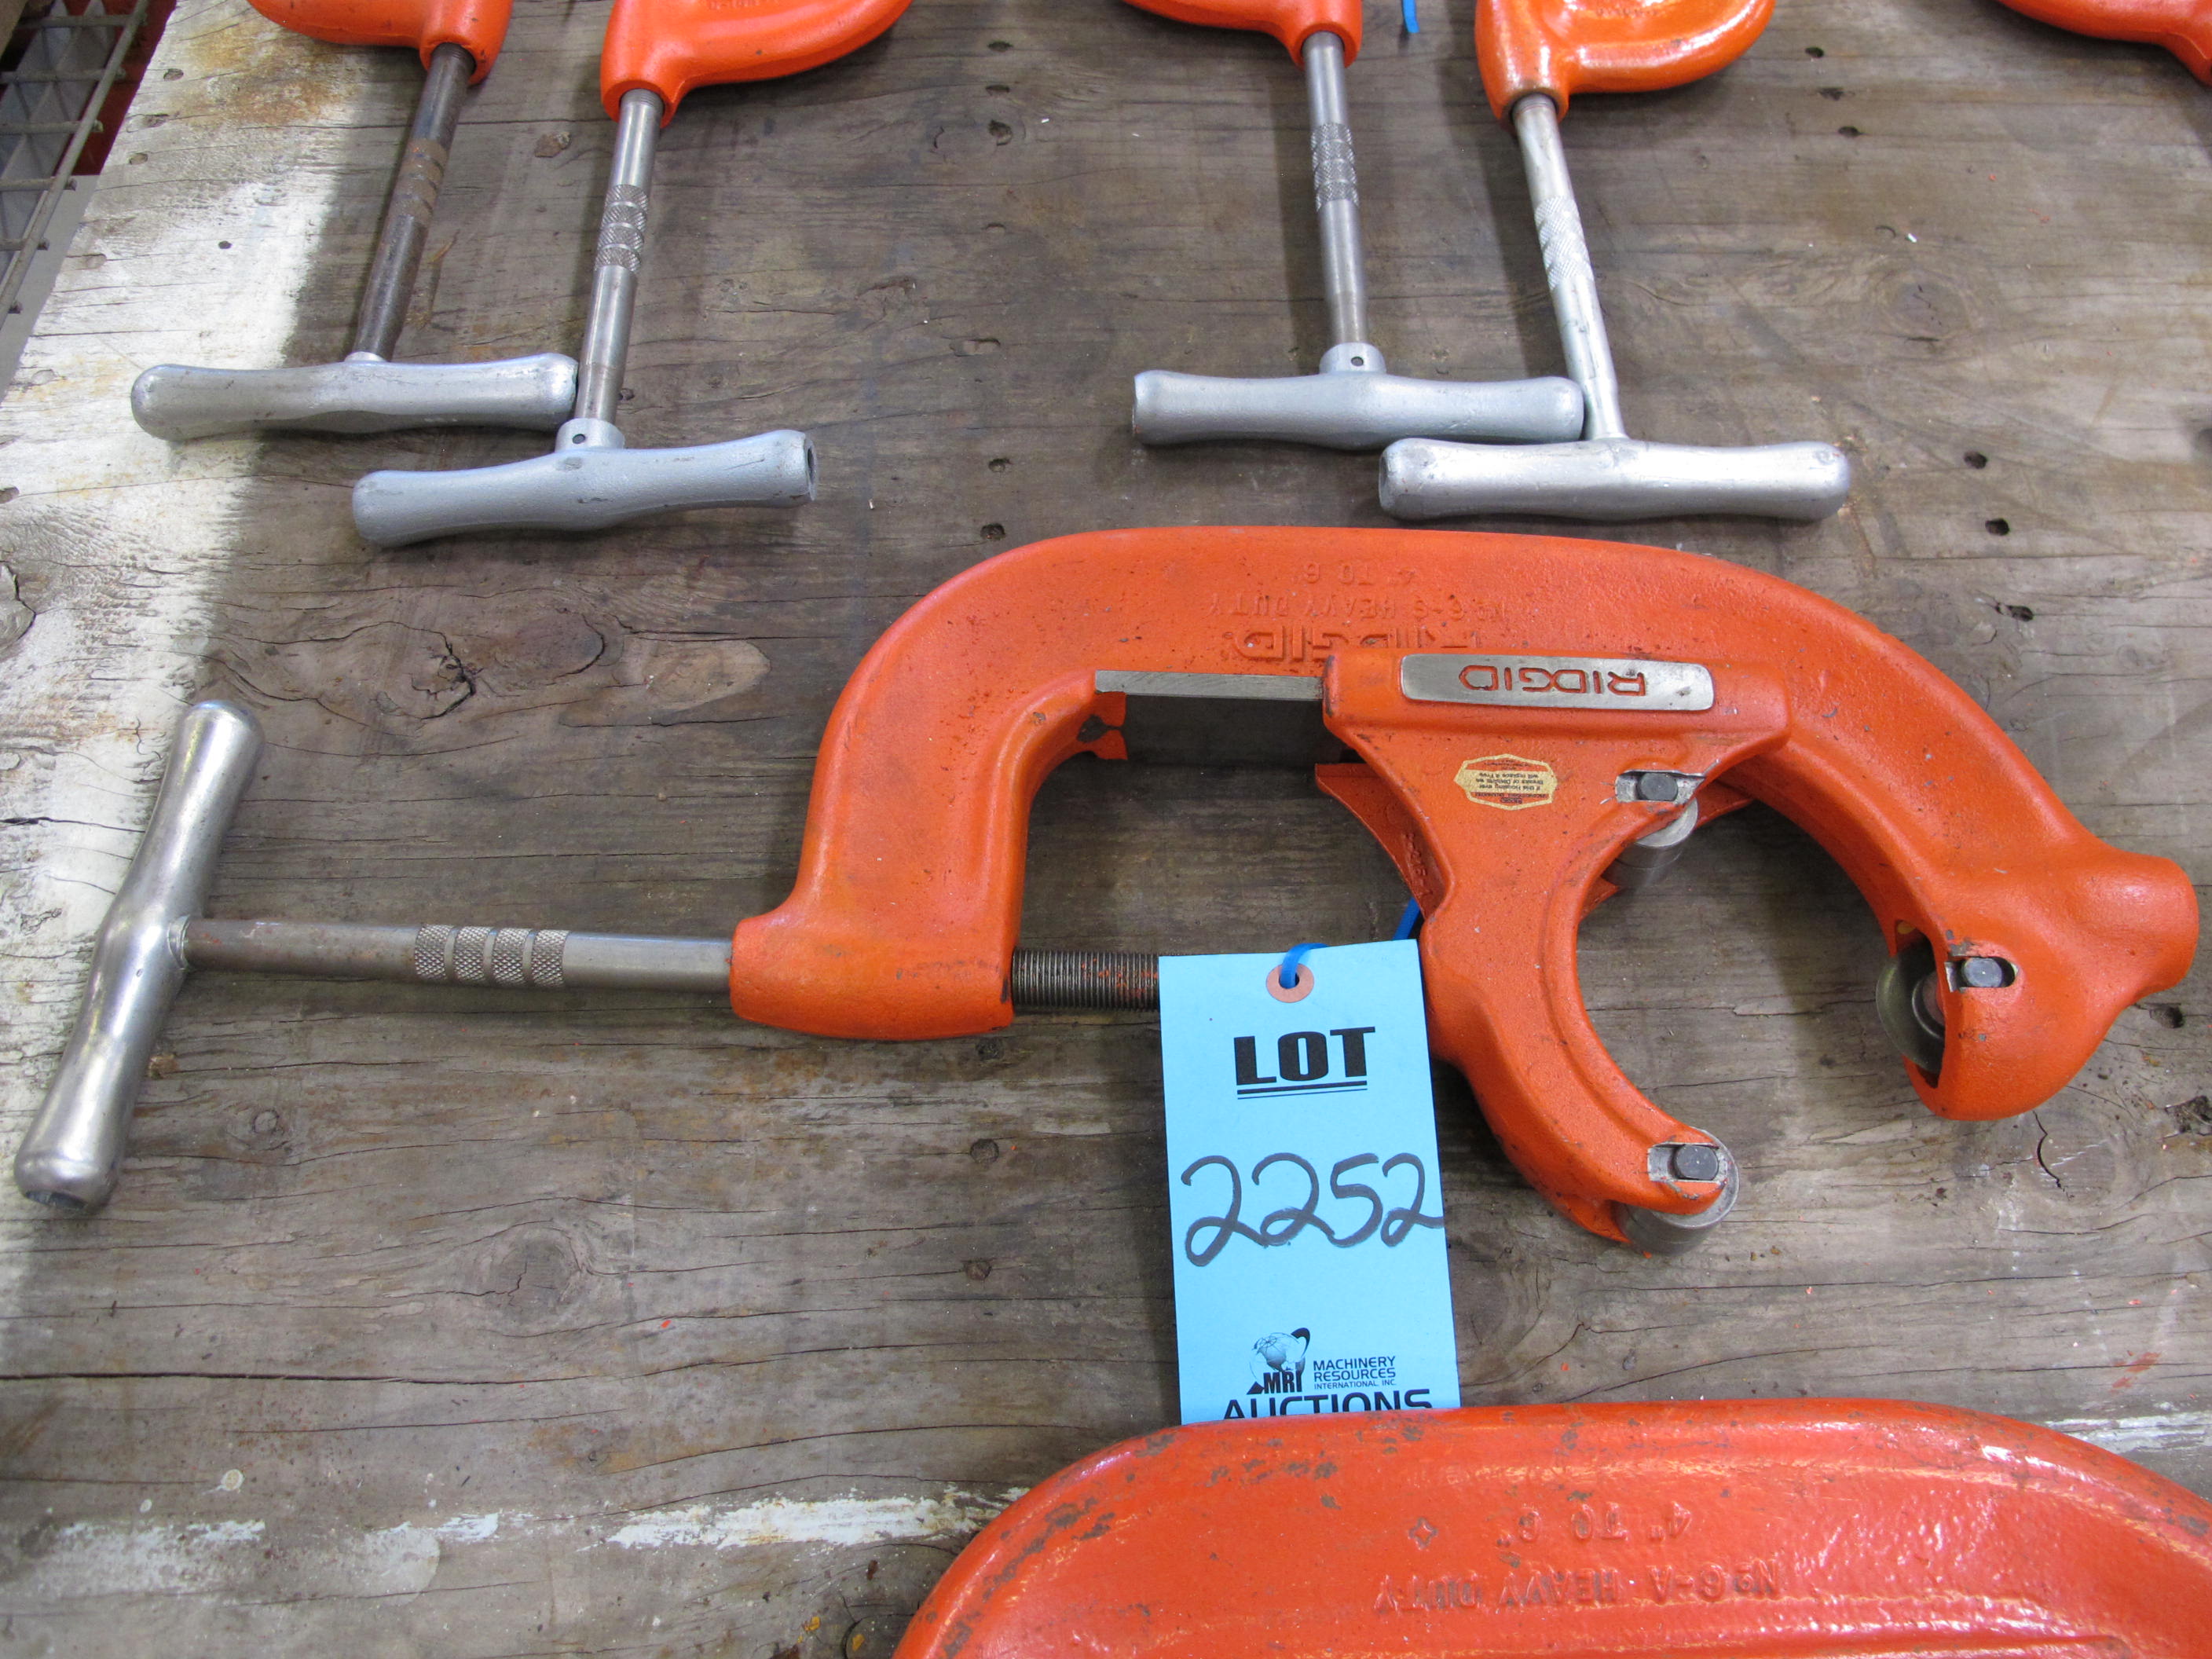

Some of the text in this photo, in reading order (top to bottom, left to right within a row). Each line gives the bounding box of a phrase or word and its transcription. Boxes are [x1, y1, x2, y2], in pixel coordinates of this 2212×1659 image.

[1459, 665, 1646, 697] RIDGID
[1233, 1026, 1376, 1086] LOT
[1181, 1152, 1445, 1267] 2252
[1313, 1356, 1396, 1371] MACHINERY
[1313, 1368, 1396, 1382] RESOURCES
[1262, 1371, 1303, 1395] MRI
[1224, 1388, 1433, 1420] AUCTIONS
[1572, 1501, 1630, 1541] TO
